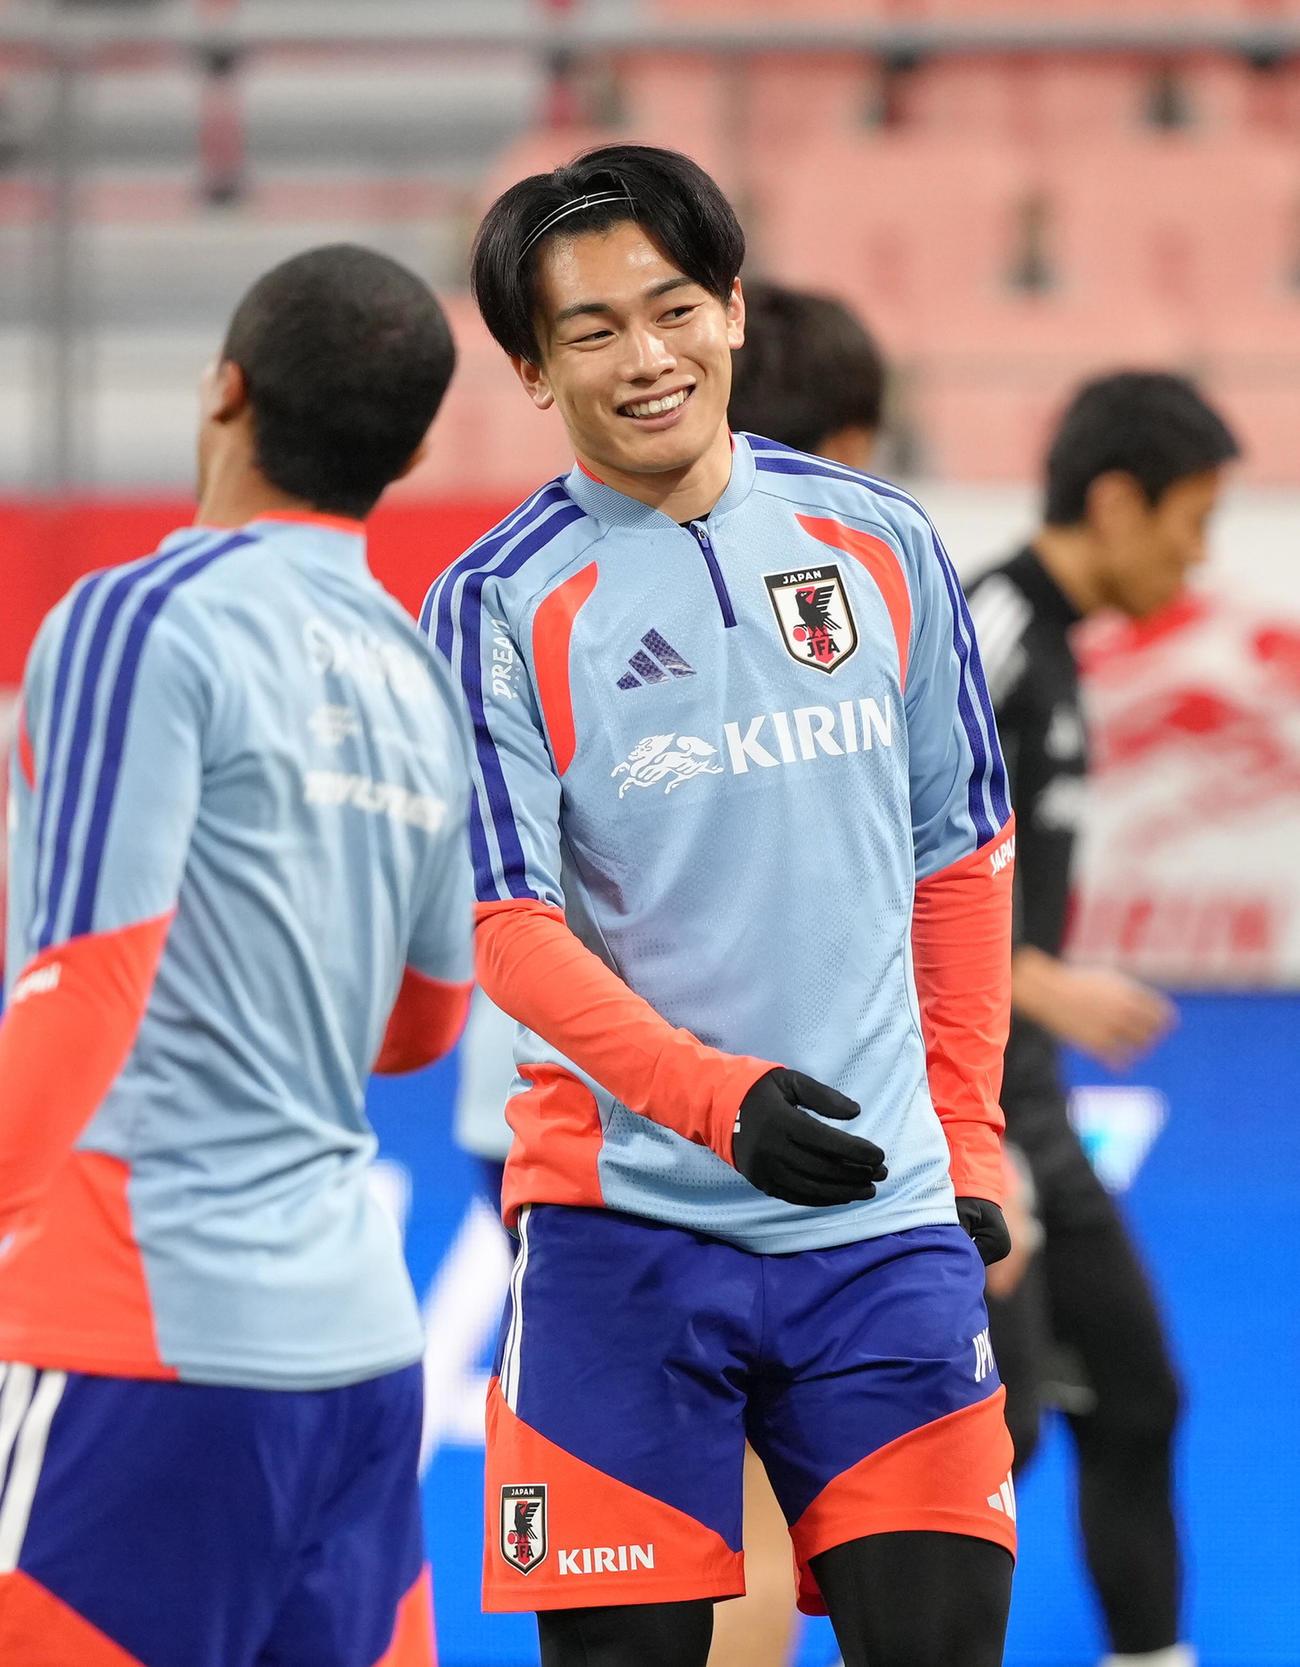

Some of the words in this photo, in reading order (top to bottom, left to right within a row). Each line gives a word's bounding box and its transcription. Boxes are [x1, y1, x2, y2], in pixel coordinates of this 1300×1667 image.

[782, 570, 822, 585] JAPAN
[807, 638, 840, 657] JFA
[724, 695, 892, 776] KIRIN
[511, 1487, 535, 1496] JAPAN
[513, 1545, 535, 1559] JFA
[557, 1543, 655, 1576] KIRIN
